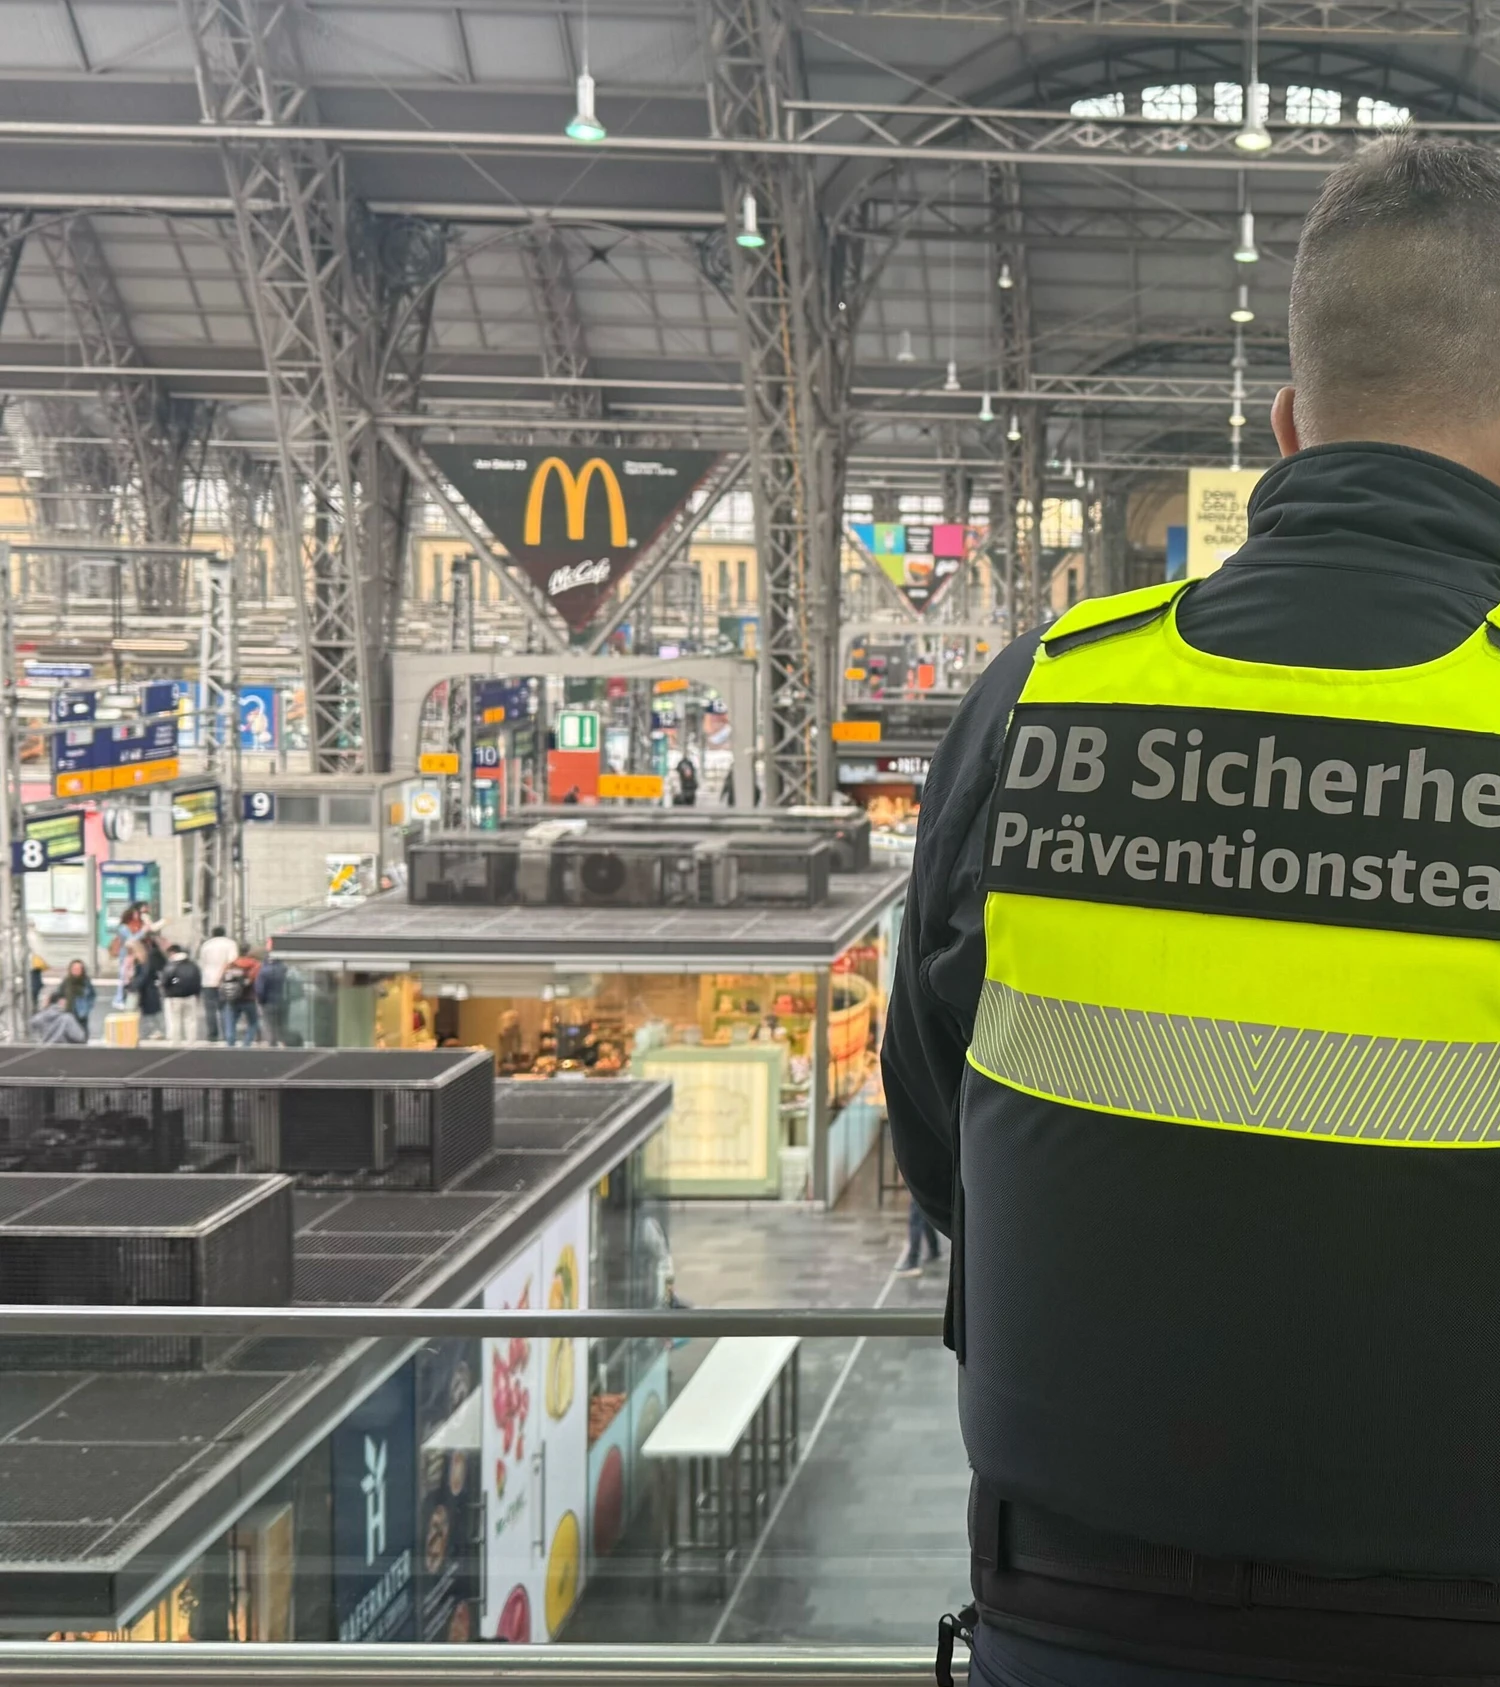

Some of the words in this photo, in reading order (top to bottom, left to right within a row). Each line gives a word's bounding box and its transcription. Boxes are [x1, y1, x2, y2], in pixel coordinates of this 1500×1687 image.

[475, 746, 497, 766] 10
[1004, 725, 1108, 793] DB
[252, 793, 270, 816] 9
[22, 839, 43, 868] 8
